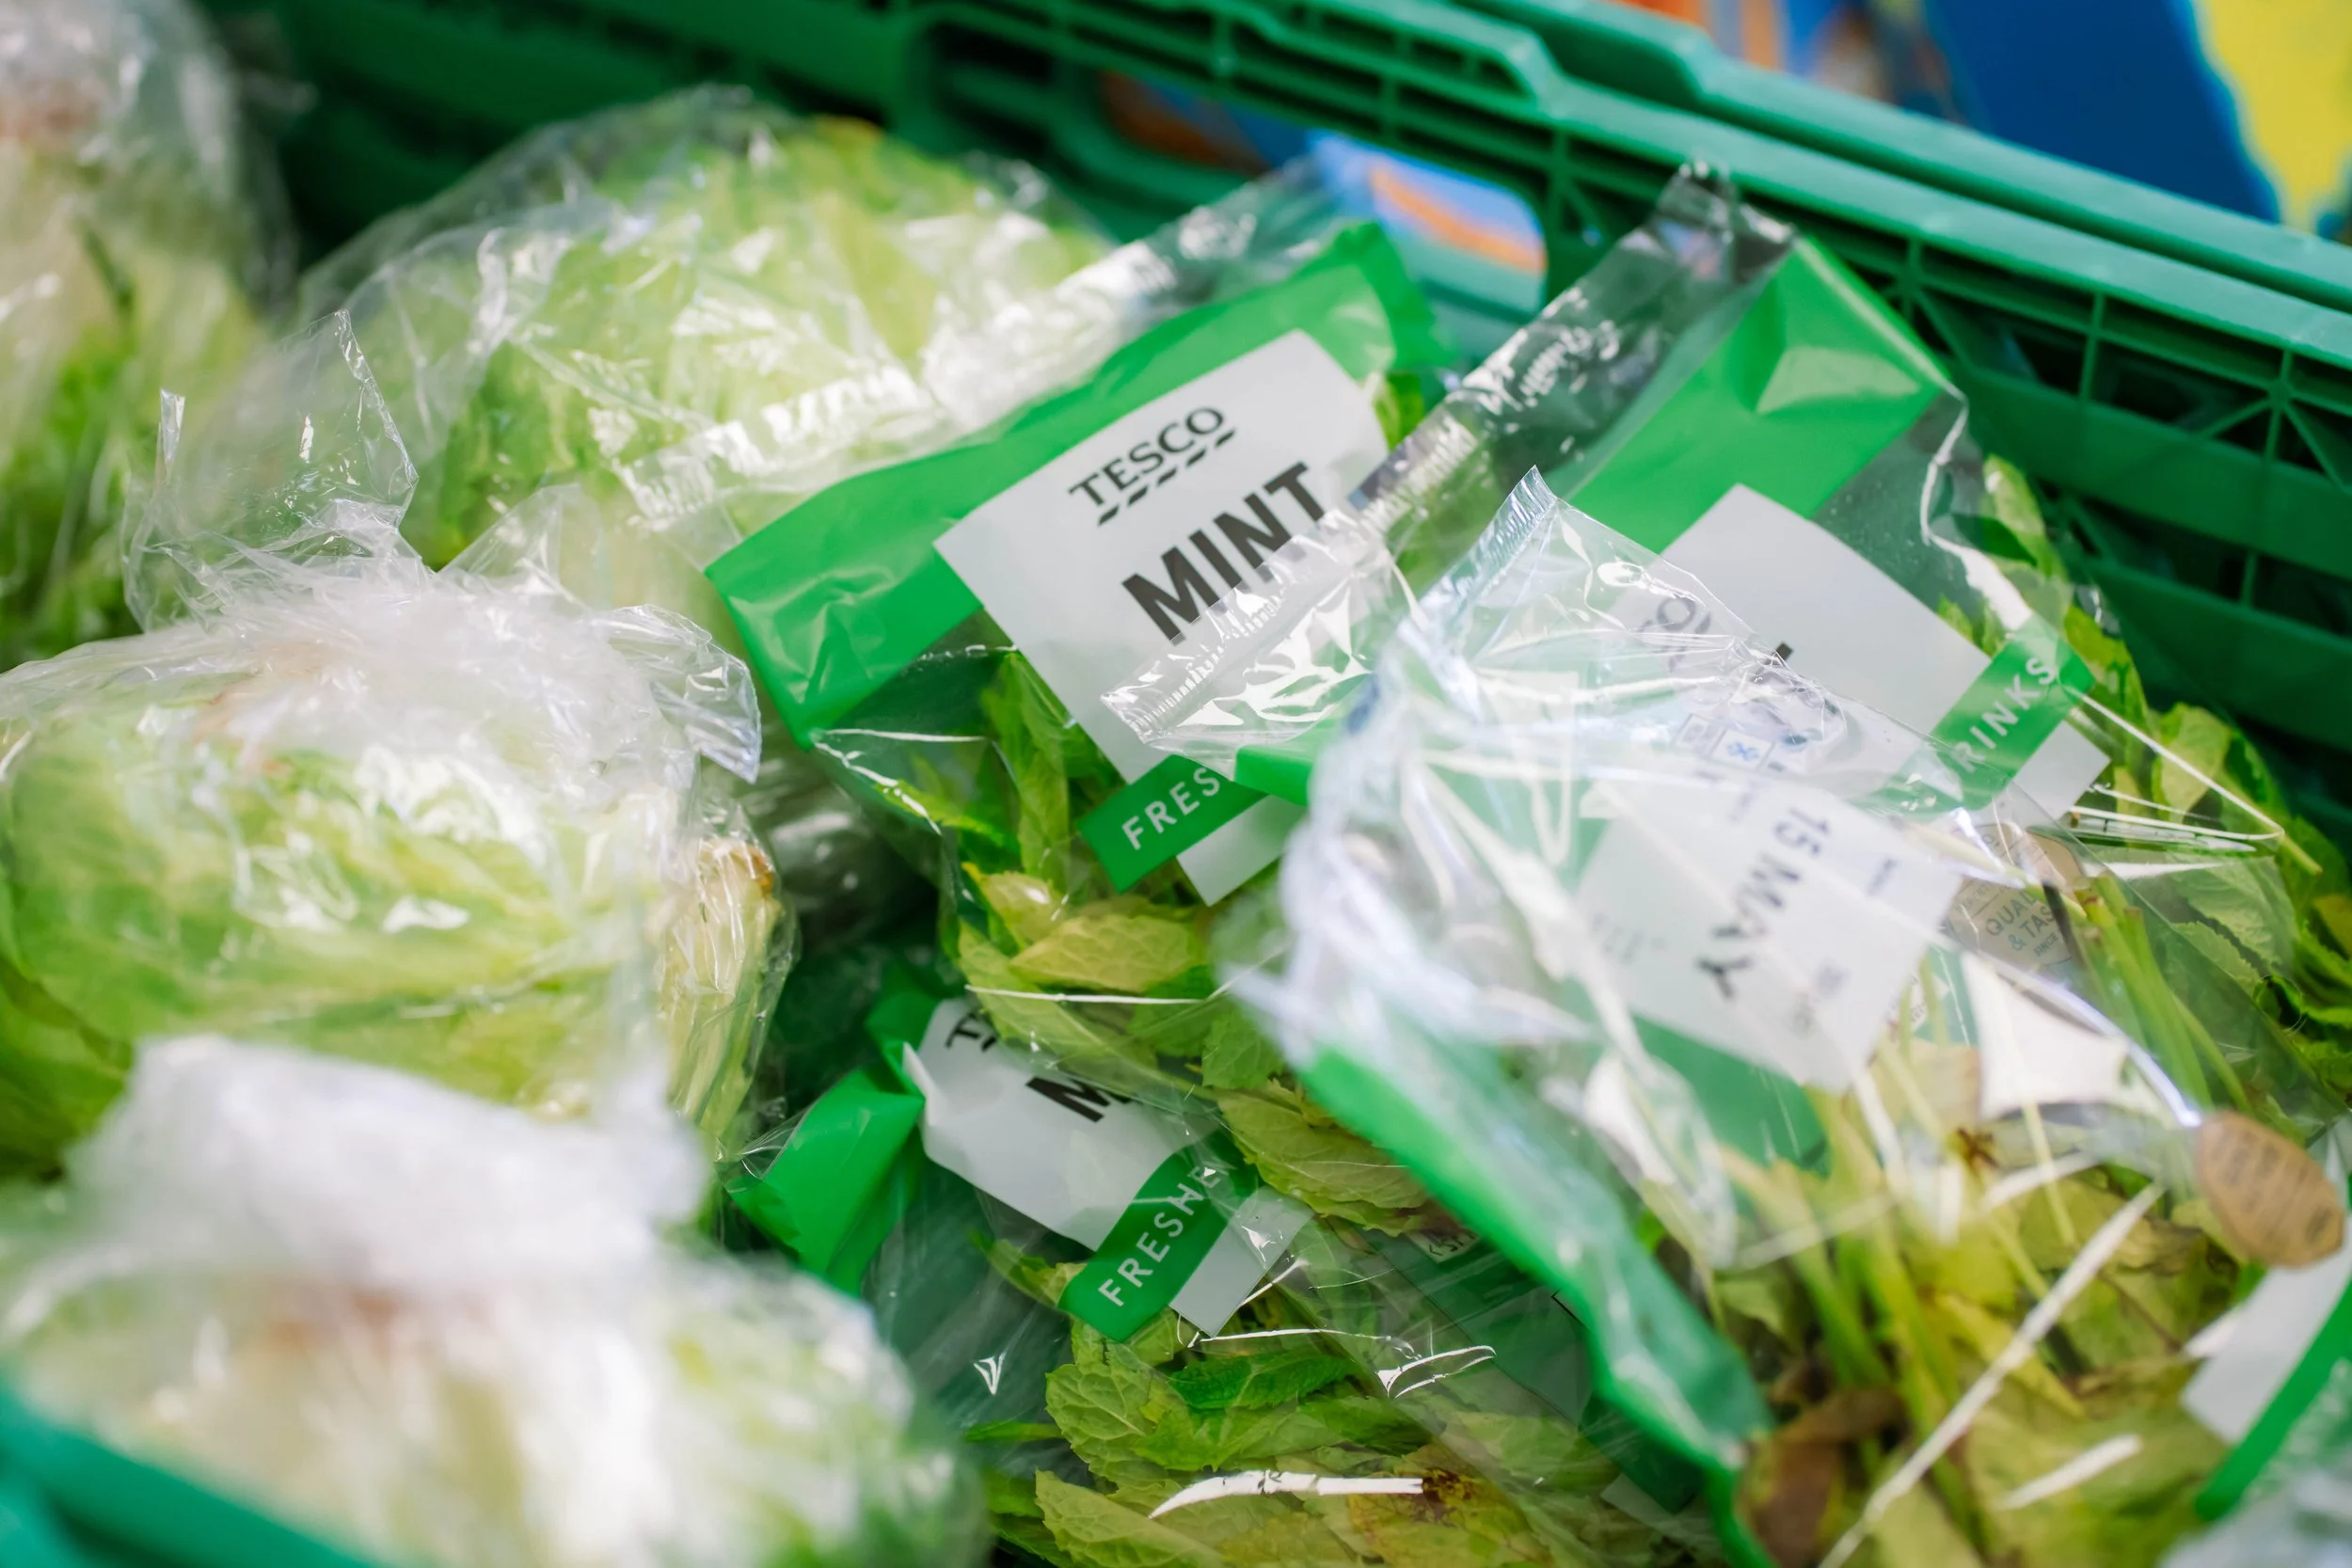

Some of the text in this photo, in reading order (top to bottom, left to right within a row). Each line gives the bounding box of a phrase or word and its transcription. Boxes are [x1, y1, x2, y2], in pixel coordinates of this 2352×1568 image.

[1069, 407, 1225, 509] TESCO
[1121, 461, 1328, 646] MINT
[1949, 657, 2056, 773] RINKS
[1121, 767, 1221, 850] FRES
[1694, 806, 1830, 1001] 15 MAY
[2019, 904, 2057, 939] TAS
